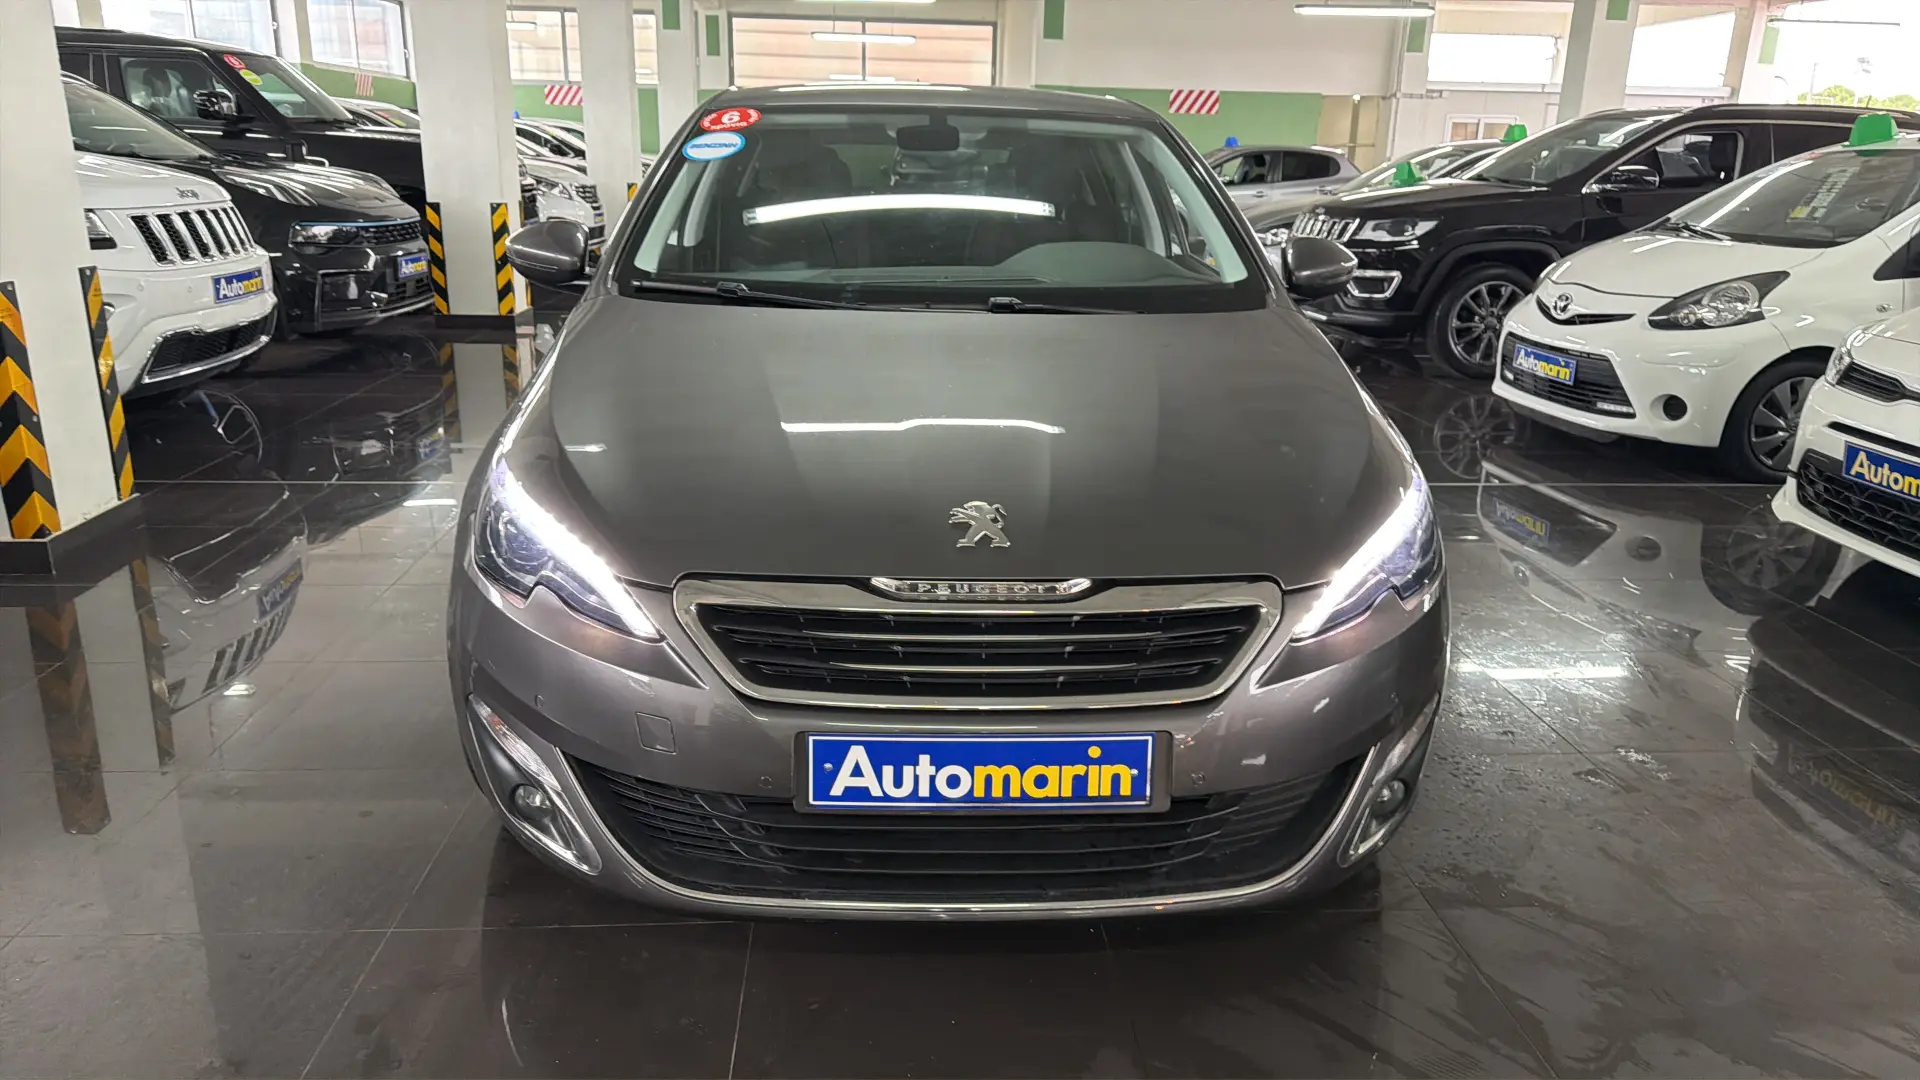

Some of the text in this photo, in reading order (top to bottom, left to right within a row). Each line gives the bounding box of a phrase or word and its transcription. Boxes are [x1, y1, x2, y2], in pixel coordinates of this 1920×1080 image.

[721, 111, 741, 124] 6
[1516, 349, 1570, 381] Automarin
[917, 582, 1045, 594] PEUGEOT
[829, 745, 1132, 798] Automarin
